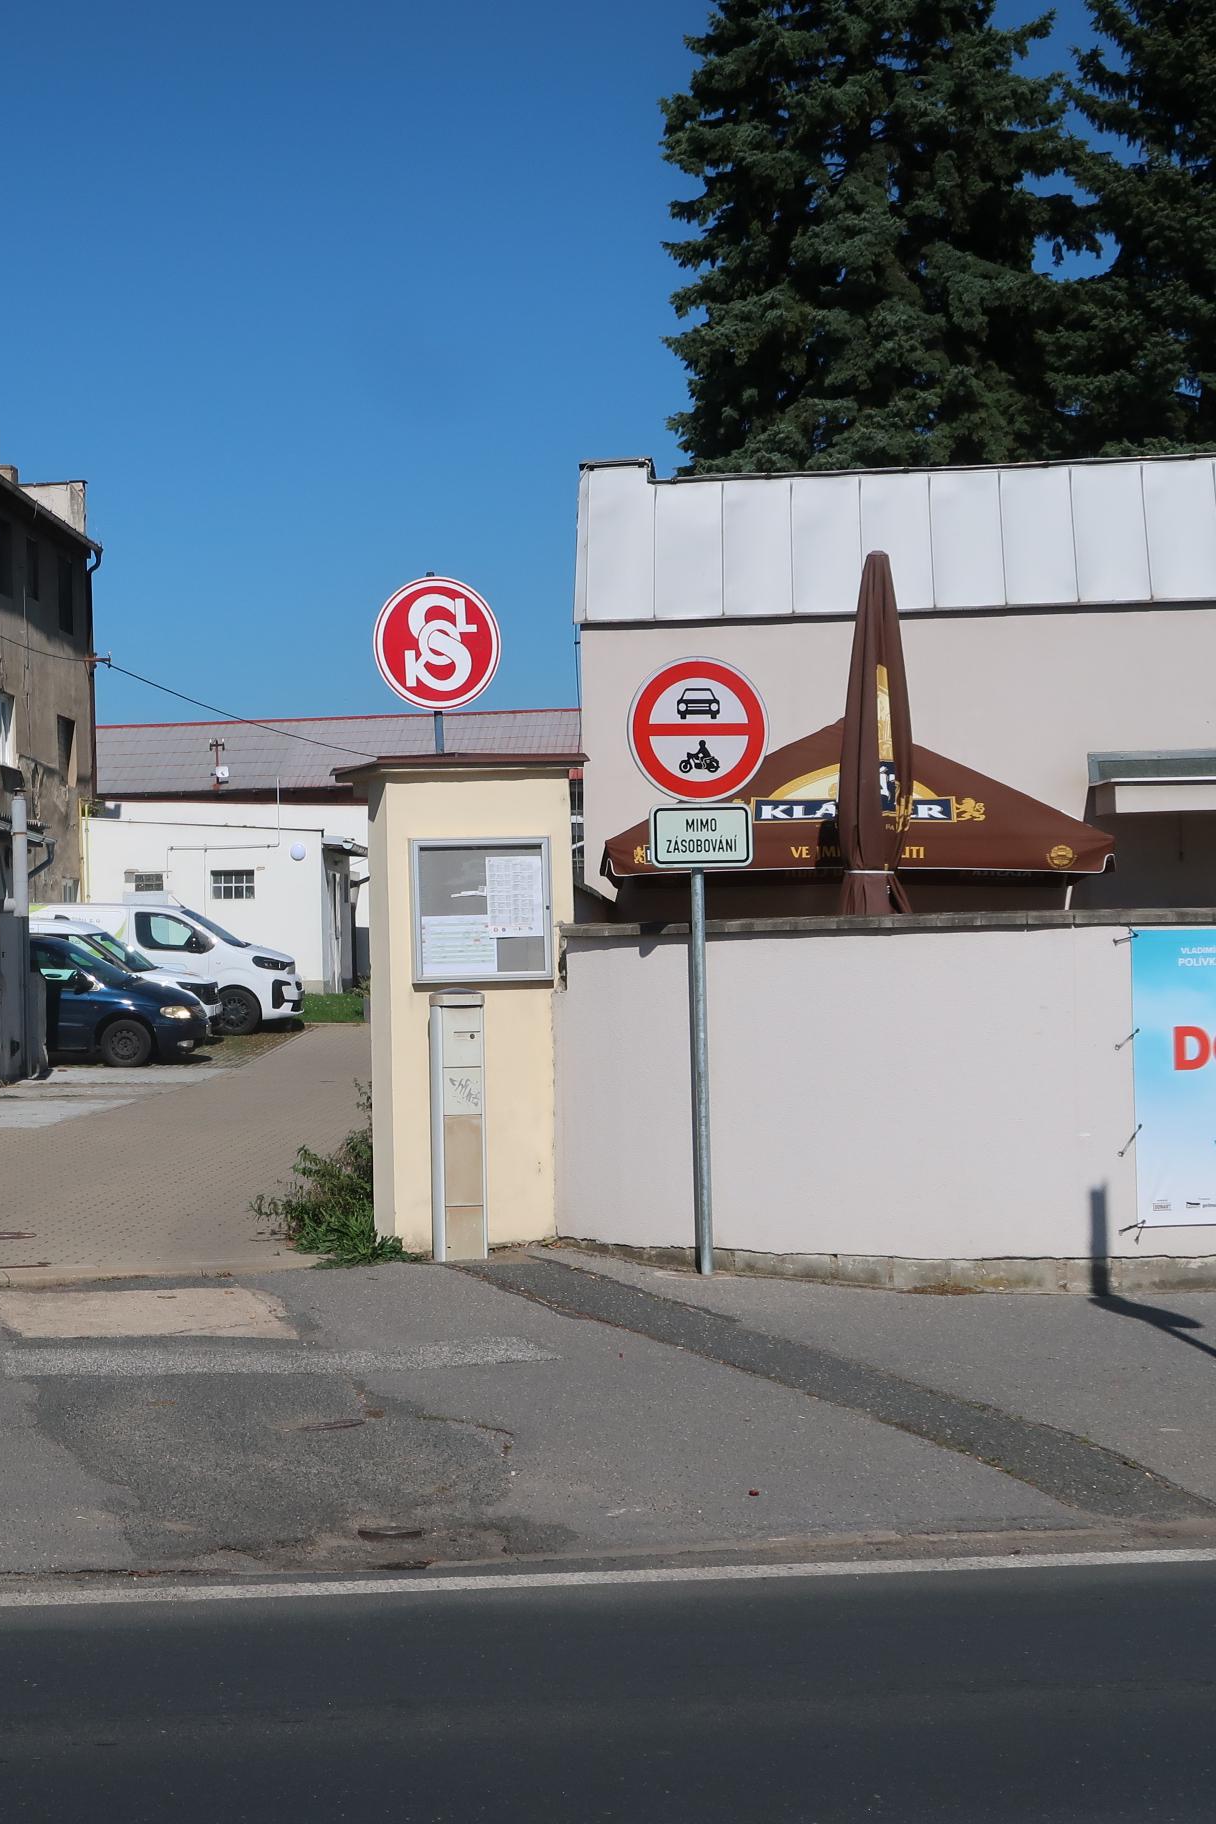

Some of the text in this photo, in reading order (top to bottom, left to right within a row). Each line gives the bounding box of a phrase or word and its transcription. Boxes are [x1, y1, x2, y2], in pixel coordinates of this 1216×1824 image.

[685, 818, 717, 832] MIMO
[666, 834, 737, 853] ZÁSOBOVÁNÍ
[790, 846, 811, 858] VE
[1178, 956, 1216, 967] POLÍVK
